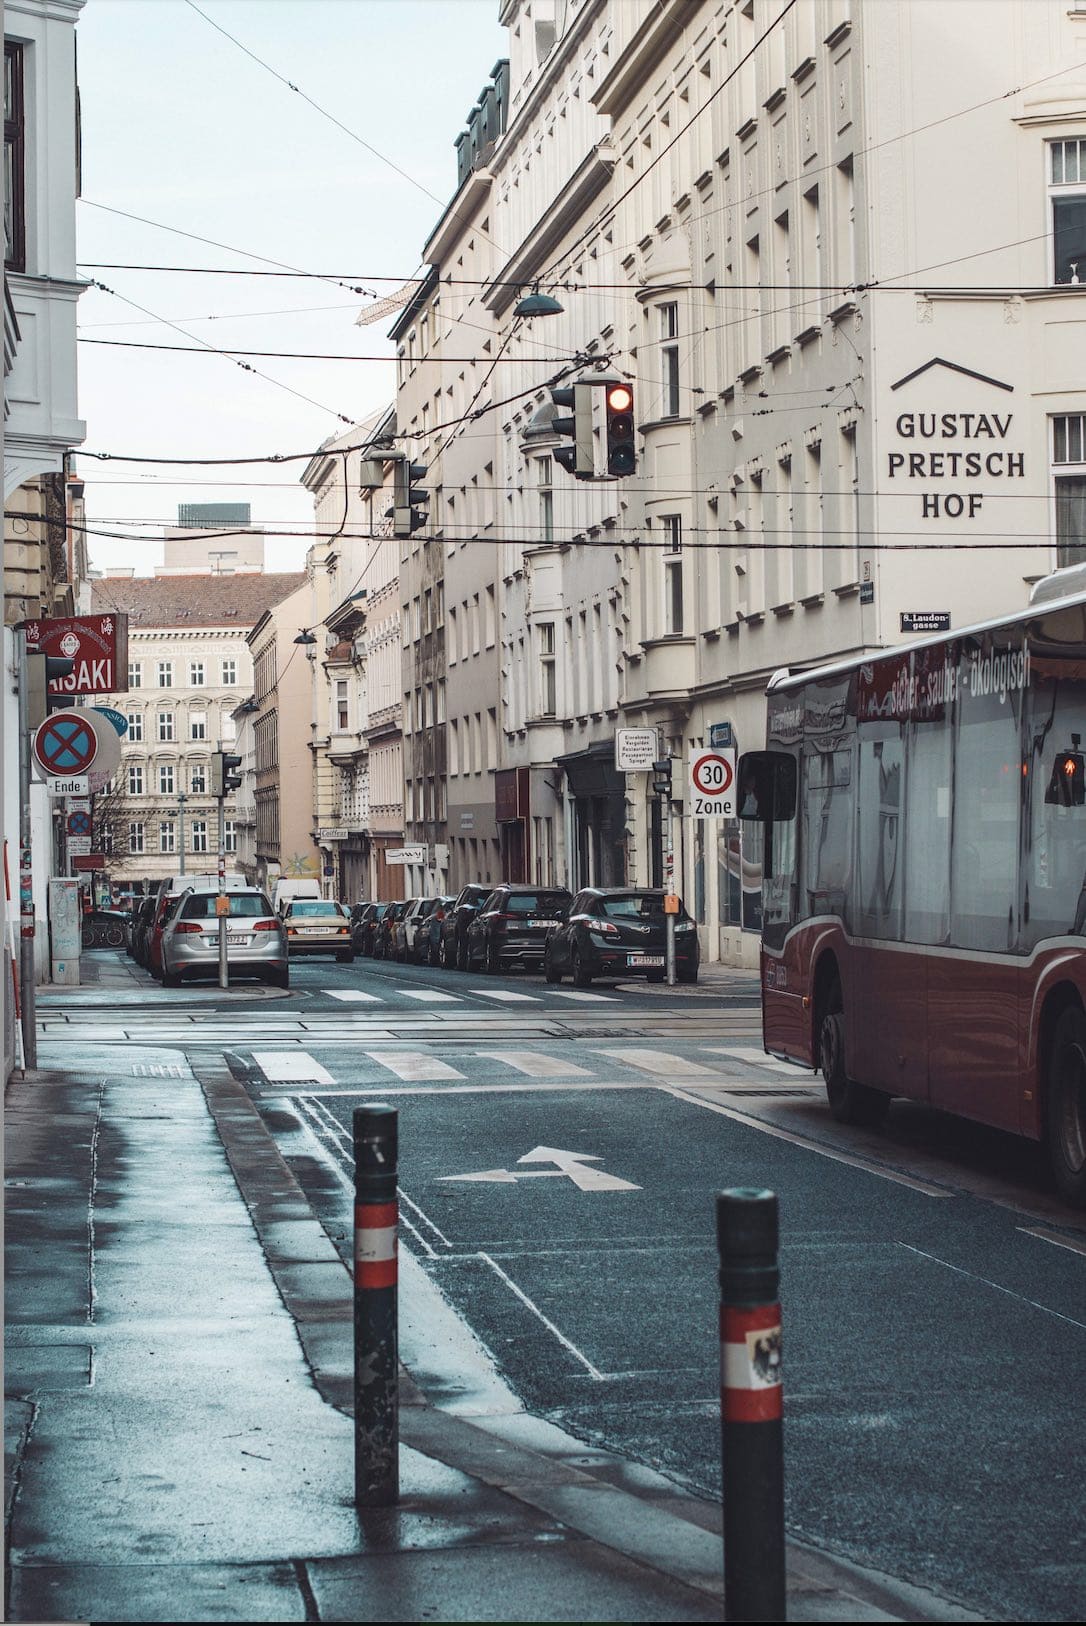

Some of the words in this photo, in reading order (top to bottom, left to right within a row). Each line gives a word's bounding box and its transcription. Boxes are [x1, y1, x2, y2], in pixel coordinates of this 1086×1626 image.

[896, 413, 1013, 438] GUSTAV
[888, 452, 1025, 478] PRETSCH
[921, 493, 984, 518] HOF
[912, 622, 939, 630] gasse
[913, 613, 948, 622] Laudon-
[49, 658, 112, 691] SAKI
[891, 666, 919, 714] sicher
[927, 658, 960, 706] sauber
[970, 638, 1031, 704] ökologisch
[54, 780, 81, 792] Ende
[703, 765, 722, 785] 30
[695, 798, 732, 814] Zone
